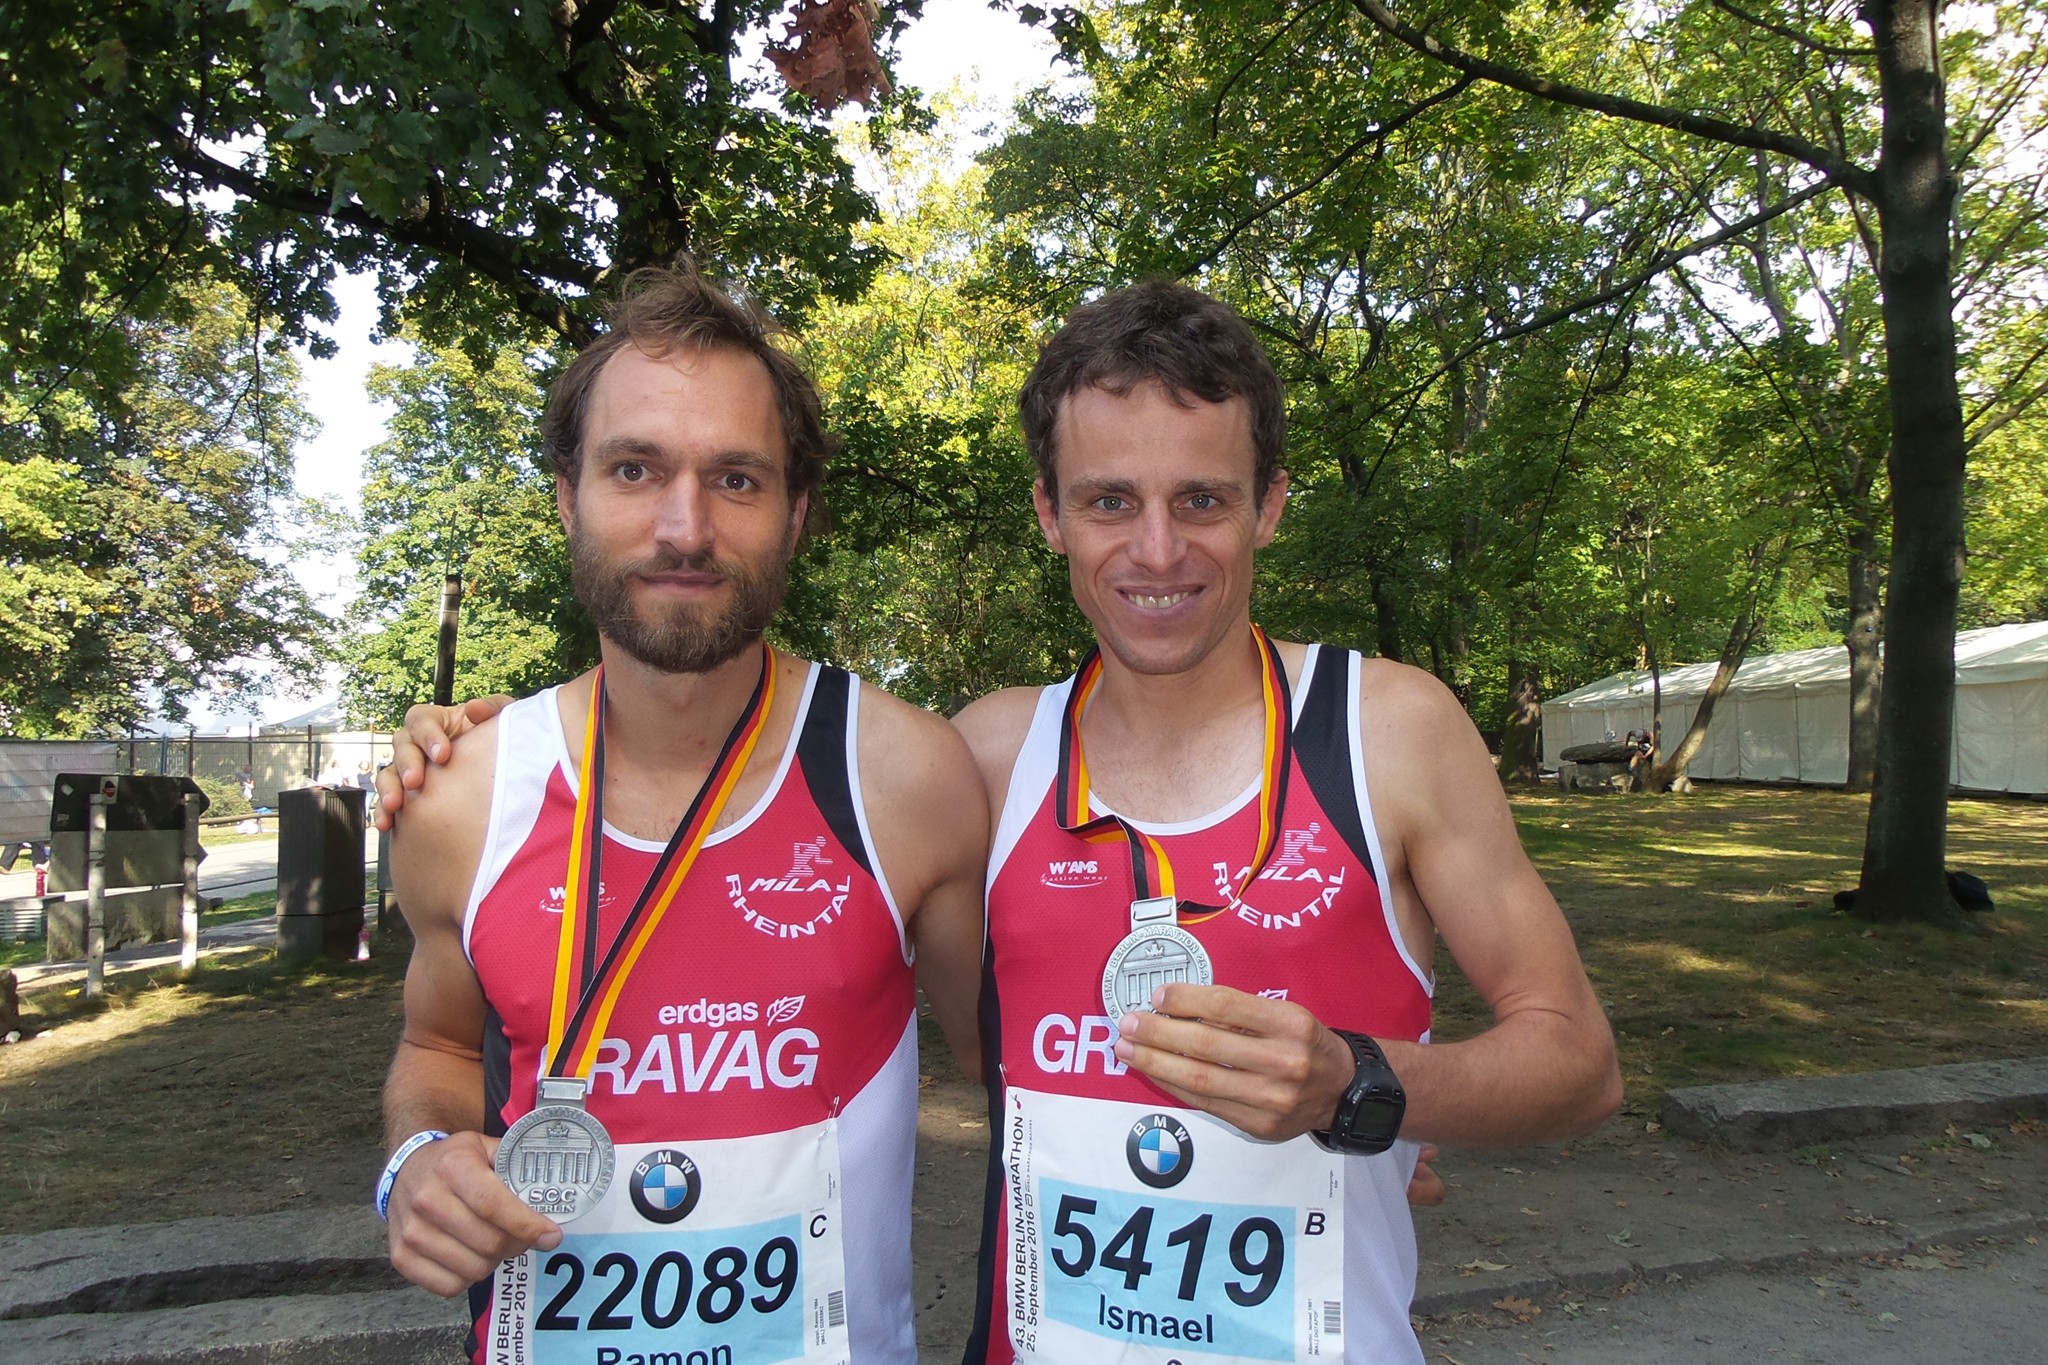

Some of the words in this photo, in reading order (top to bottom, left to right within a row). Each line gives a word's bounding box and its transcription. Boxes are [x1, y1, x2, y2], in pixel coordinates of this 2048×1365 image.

[725, 873, 851, 939] RHEINTAL
[1213, 862, 1345, 930] RHEINTAL
[1104, 971, 1114, 1000] BMW
[658, 997, 759, 1028] erdgas
[539, 1026, 821, 1095] RAVAG
[1132, 1115, 1189, 1143] BMW
[635, 1151, 696, 1177] BMW
[529, 1185, 577, 1205] SCC
[1009, 1116, 1026, 1276] BERLIN-MARATHON
[809, 1214, 828, 1239] C
[1025, 1210, 1037, 1246] 2016
[1304, 1211, 1326, 1236] B
[1051, 1194, 1285, 1308] 5419
[514, 1272, 528, 1311] 2016
[534, 1235, 799, 1331] 22089
[1014, 1278, 1026, 1321] BMW
[1026, 1247, 1039, 1327] September
[496, 1257, 515, 1349] BERLIN-M
[1099, 1294, 1213, 1344] Ismael
[1014, 1324, 1026, 1348] 43.
[1026, 1330, 1037, 1352] 25.
